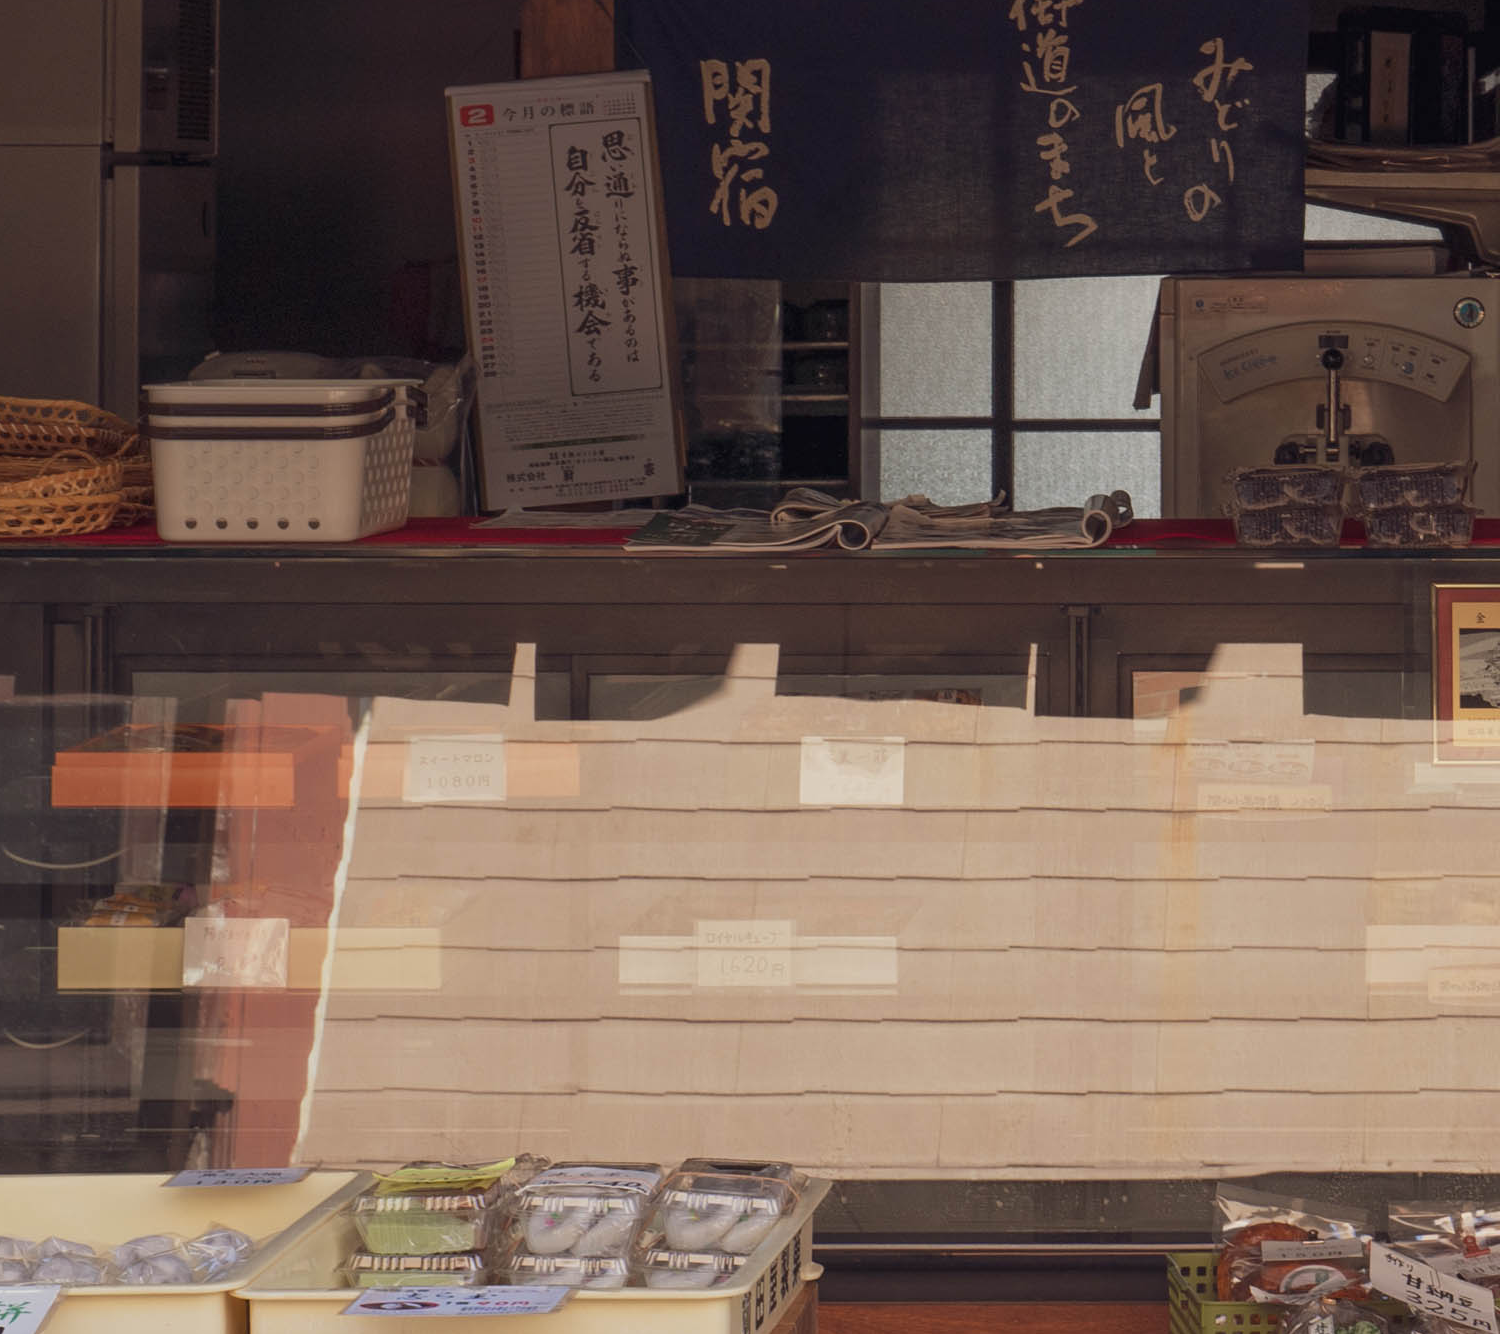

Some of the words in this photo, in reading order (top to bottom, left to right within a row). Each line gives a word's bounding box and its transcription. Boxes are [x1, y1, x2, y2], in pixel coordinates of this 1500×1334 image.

[502, 102, 595, 123] 今月の標語
[1185, 38, 1253, 223] みどりの
[1405, 1289, 1492, 1331] 325円
